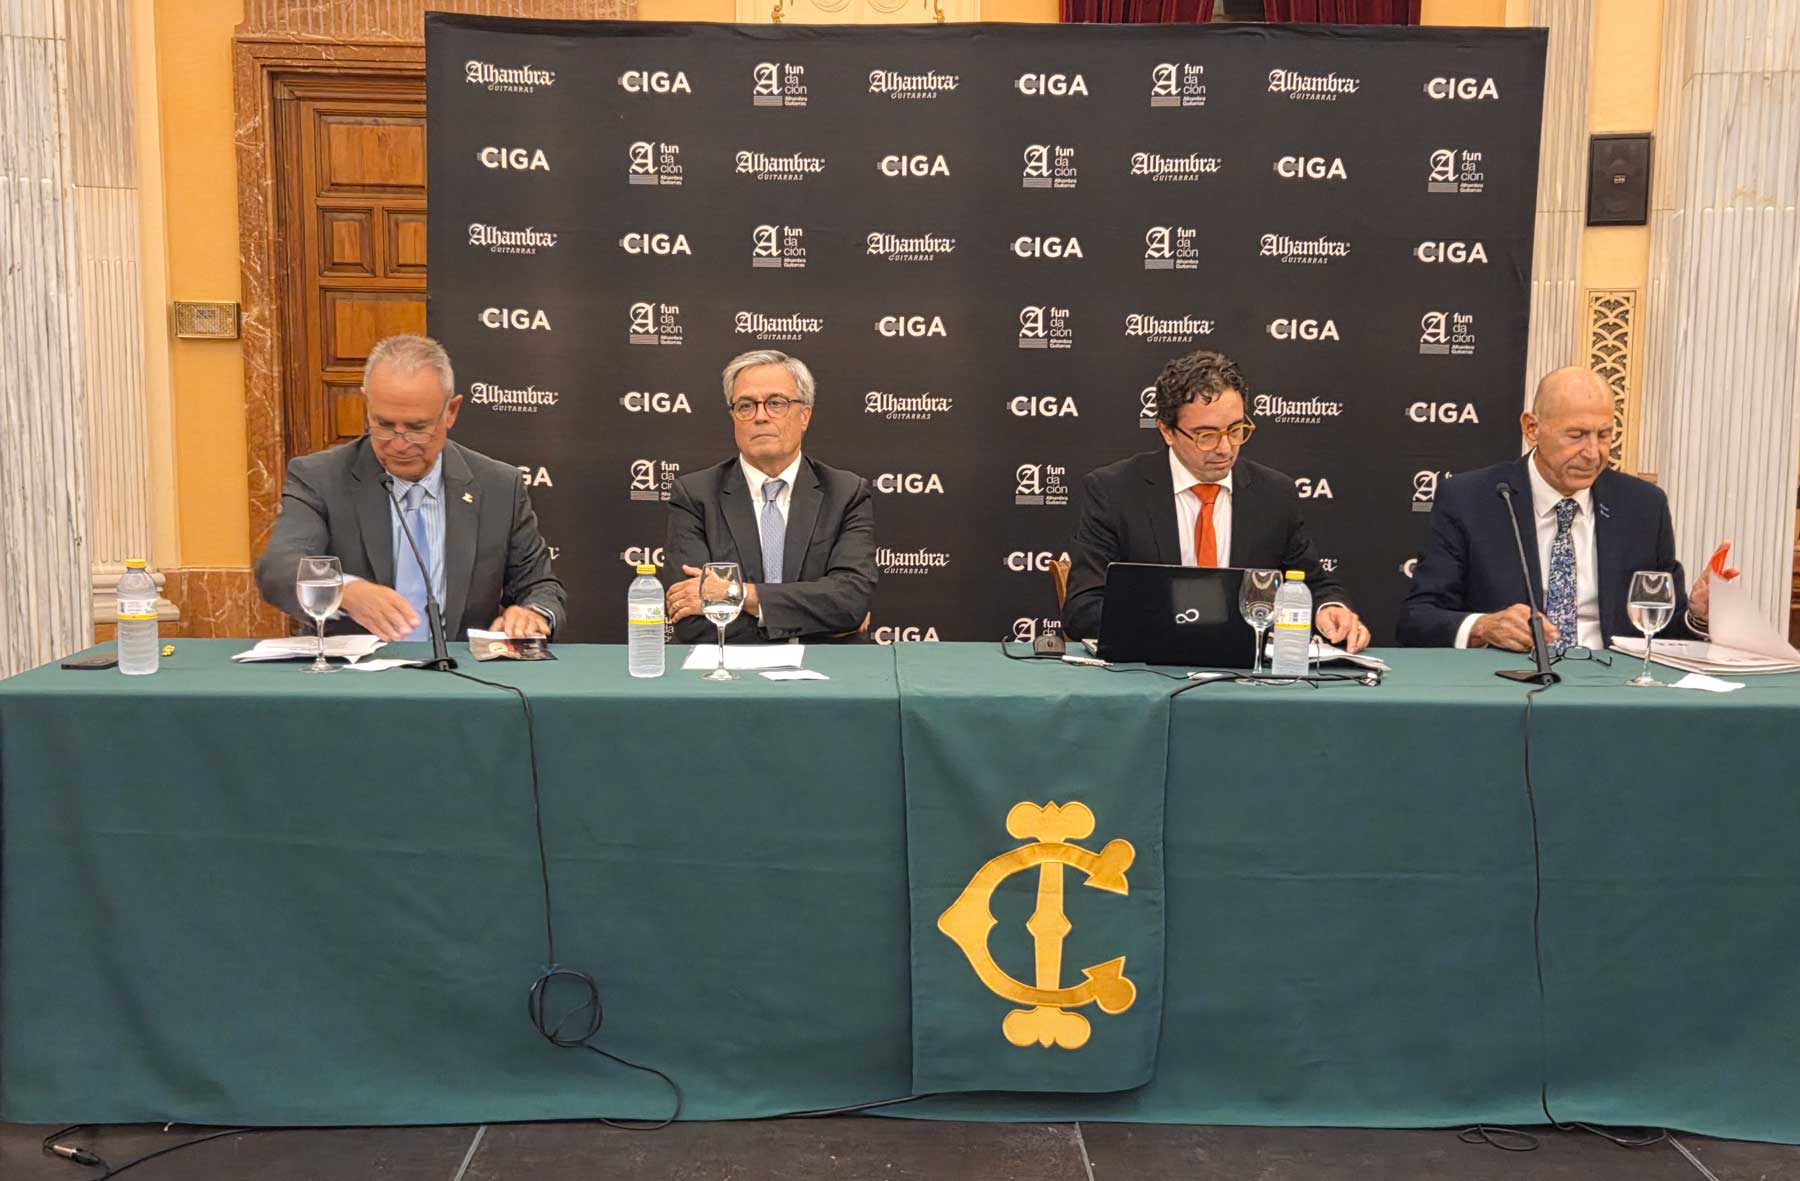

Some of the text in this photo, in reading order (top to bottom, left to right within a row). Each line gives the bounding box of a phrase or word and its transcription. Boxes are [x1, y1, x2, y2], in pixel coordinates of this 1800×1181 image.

[785, 63, 805, 73] fun
[1184, 64, 1204, 74] fun
[466, 61, 555, 87] Alhambra
[754, 62, 782, 95] A
[785, 74, 799, 84] da
[1152, 63, 1181, 95] A
[1184, 74, 1197, 84] da
[622, 71, 691, 92] CIGA
[869, 70, 959, 94] Alhambra
[1019, 74, 1088, 95] CIGA
[1268, 69, 1359, 94] Alhambra
[487, 85, 534, 94] GUITARRAS
[785, 84, 807, 94] ción
[1184, 84, 1206, 95] ción
[1428, 78, 1498, 99] CIGA
[891, 92, 937, 100] GUITARRAS
[1290, 92, 1337, 101] GUITARRAS
[661, 143, 681, 153] fun
[1055, 146, 1075, 156] fun
[481, 148, 549, 170] CIGA
[629, 142, 658, 174] A
[661, 153, 674, 163] da
[1461, 150, 1482, 160] fun
[736, 151, 825, 175] Alhambra
[882, 156, 949, 176] CIGA
[1023, 145, 1052, 177] A
[1055, 156, 1068, 166] da
[1131, 153, 1221, 176] Alhambra
[1429, 149, 1458, 181] A
[1461, 160, 1475, 170] da
[661, 163, 683, 174] ción
[1055, 166, 1077, 177] ción
[1278, 157, 1346, 179] CIGA
[757, 173, 804, 181] GUITARRAS
[1153, 174, 1199, 182] GUITARRAS
[1461, 170, 1484, 181] ción
[469, 223, 557, 248] Alhambra
[784, 226, 804, 236] fun
[1177, 228, 1197, 238] fun
[623, 234, 691, 254] CIGA
[753, 225, 781, 256] A
[784, 236, 798, 246] da
[867, 232, 955, 256] Alhambra
[1146, 227, 1174, 258] A
[1177, 238, 1191, 248] da
[1260, 234, 1350, 258] Alhambra
[490, 246, 536, 255] GUITARRAS
[784, 246, 806, 256] ción
[1015, 237, 1082, 257] CIGA
[1418, 242, 1487, 262] CIGA
[888, 254, 934, 262] GUITARRAS
[1177, 248, 1199, 258] ción
[1282, 256, 1328, 264] GUITARRAS
[661, 303, 681, 313] fun
[1050, 307, 1070, 317] fun
[483, 308, 550, 330] CIGA
[630, 302, 658, 333] A
[661, 313, 675, 323] da
[1019, 306, 1047, 337] A
[1050, 317, 1064, 327] da
[1453, 313, 1473, 323] fun
[661, 323, 683, 333] ción
[735, 312, 823, 335] Alhambra
[879, 317, 946, 336] CIGA
[1125, 314, 1214, 337] Alhambra
[1421, 312, 1450, 343] A
[1453, 323, 1466, 333] da
[1050, 327, 1072, 337] ción
[1271, 319, 1339, 340] CIGA
[756, 333, 802, 341] GUITARRAS
[1146, 335, 1193, 343] GUITARRAS
[1453, 333, 1475, 343] ción
[471, 383, 558, 407] Alhambra
[624, 392, 691, 413] CIGA
[865, 392, 952, 414] Alhambra
[1011, 397, 1078, 416] CIGA
[1254, 393, 1343, 417] Alhambra
[492, 405, 537, 413] GUITARRAS
[1410, 403, 1478, 423] CIGA
[886, 412, 931, 420] GUITARRAS
[1275, 415, 1322, 423] GUITARRAS
[661, 461, 679, 471] fun
[1046, 465, 1066, 474] fun
[631, 460, 659, 489] A
[1016, 464, 1044, 494] A
[1046, 475, 1060, 484] da
[877, 474, 943, 493] CIGA
[1046, 484, 1068, 493] ción
[1295, 478, 1334, 498] GA
[876, 547, 949, 568] lhambra
[883, 567, 929, 575] GUITARRAS
[1042, 618, 1061, 629] fun
[874, 626, 941, 645] CIGA
